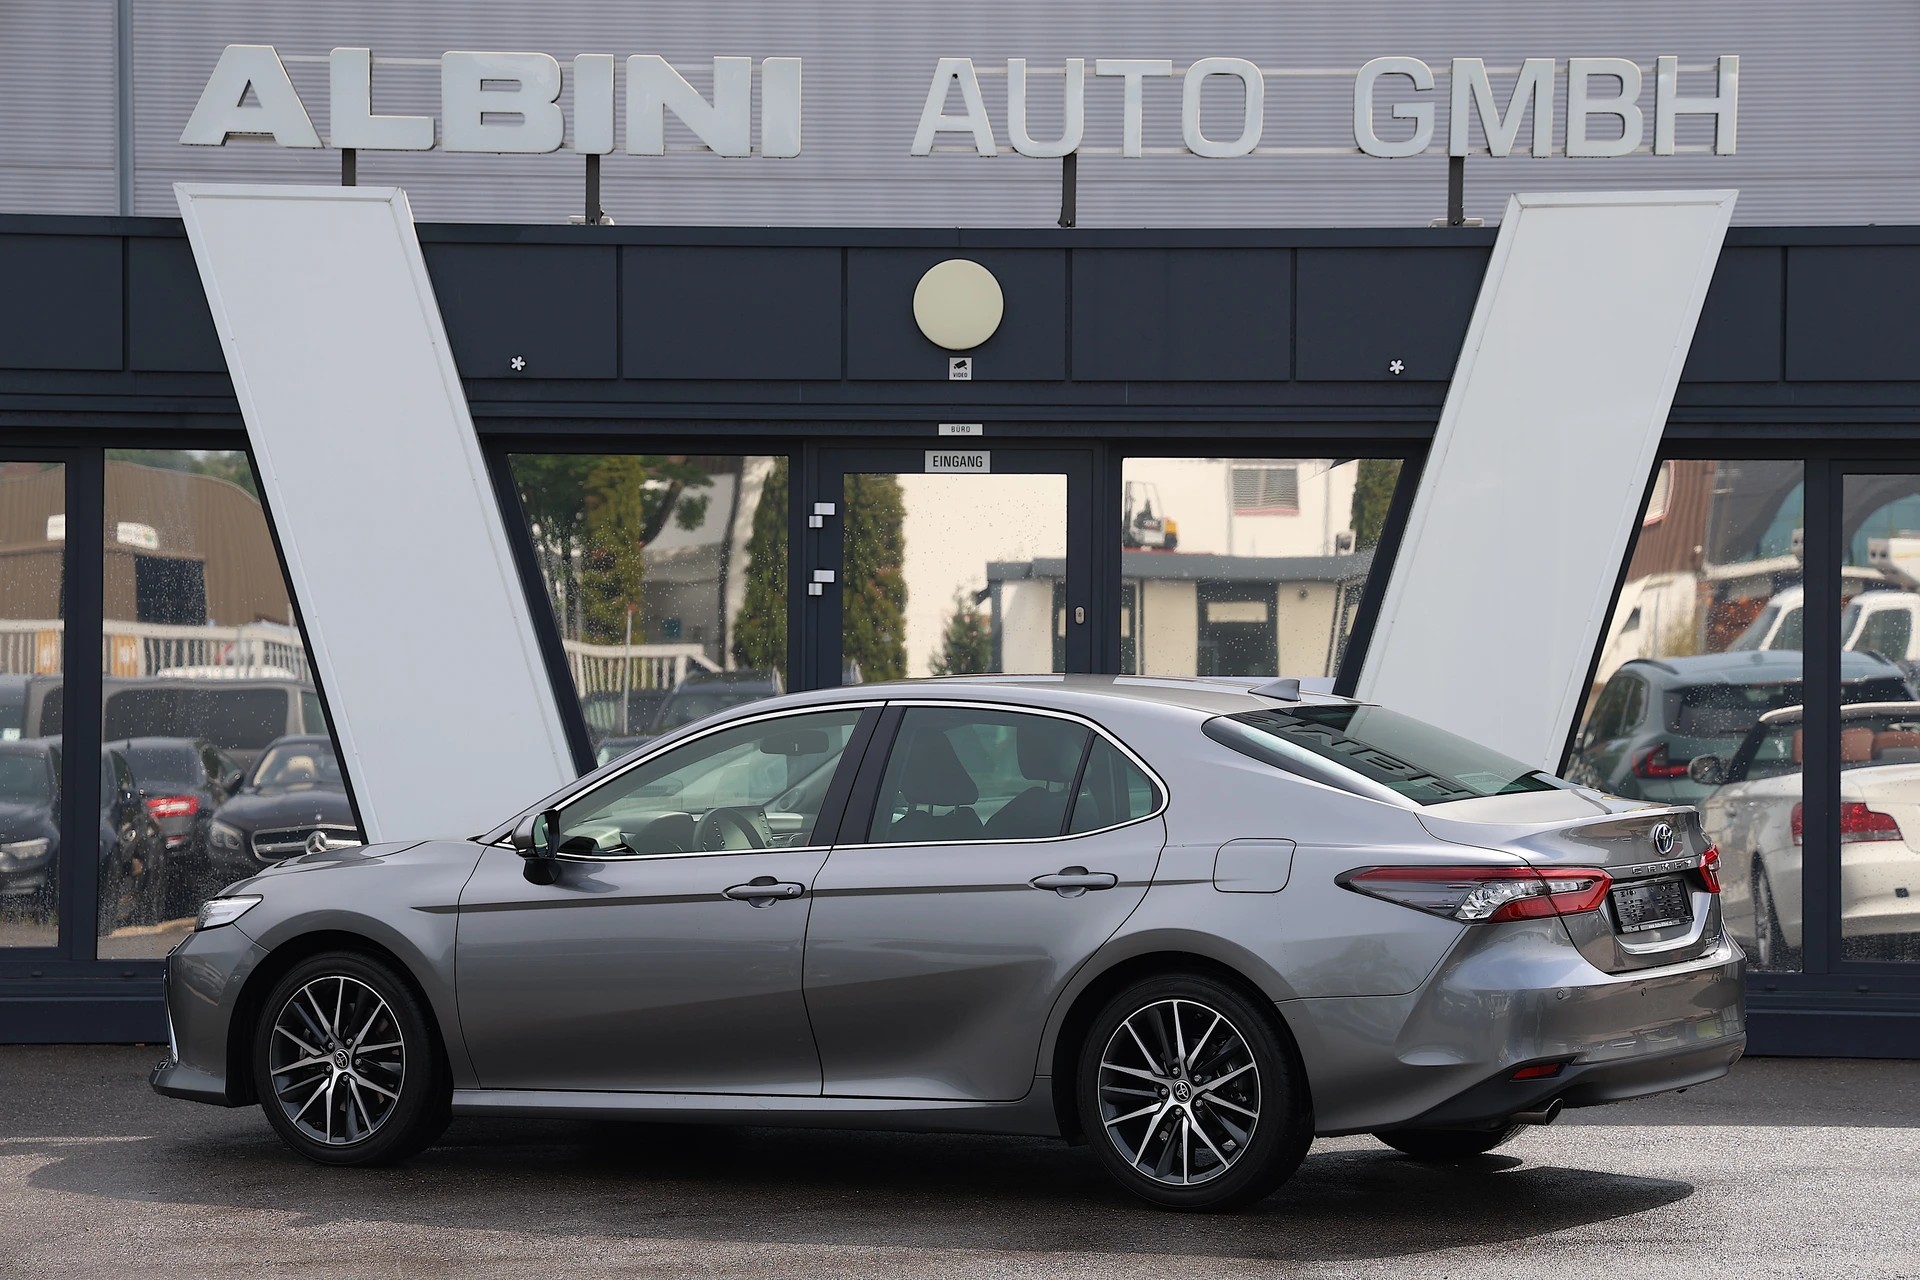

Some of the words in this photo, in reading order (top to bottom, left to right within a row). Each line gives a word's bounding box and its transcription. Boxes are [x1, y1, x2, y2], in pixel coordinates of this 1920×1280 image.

[179, 44, 802, 159] ALBINI
[910, 56, 1264, 159] AUTO
[1353, 55, 1740, 159] GMBH
[950, 424, 971, 433] BÜRO
[932, 455, 983, 468] EINGANG
